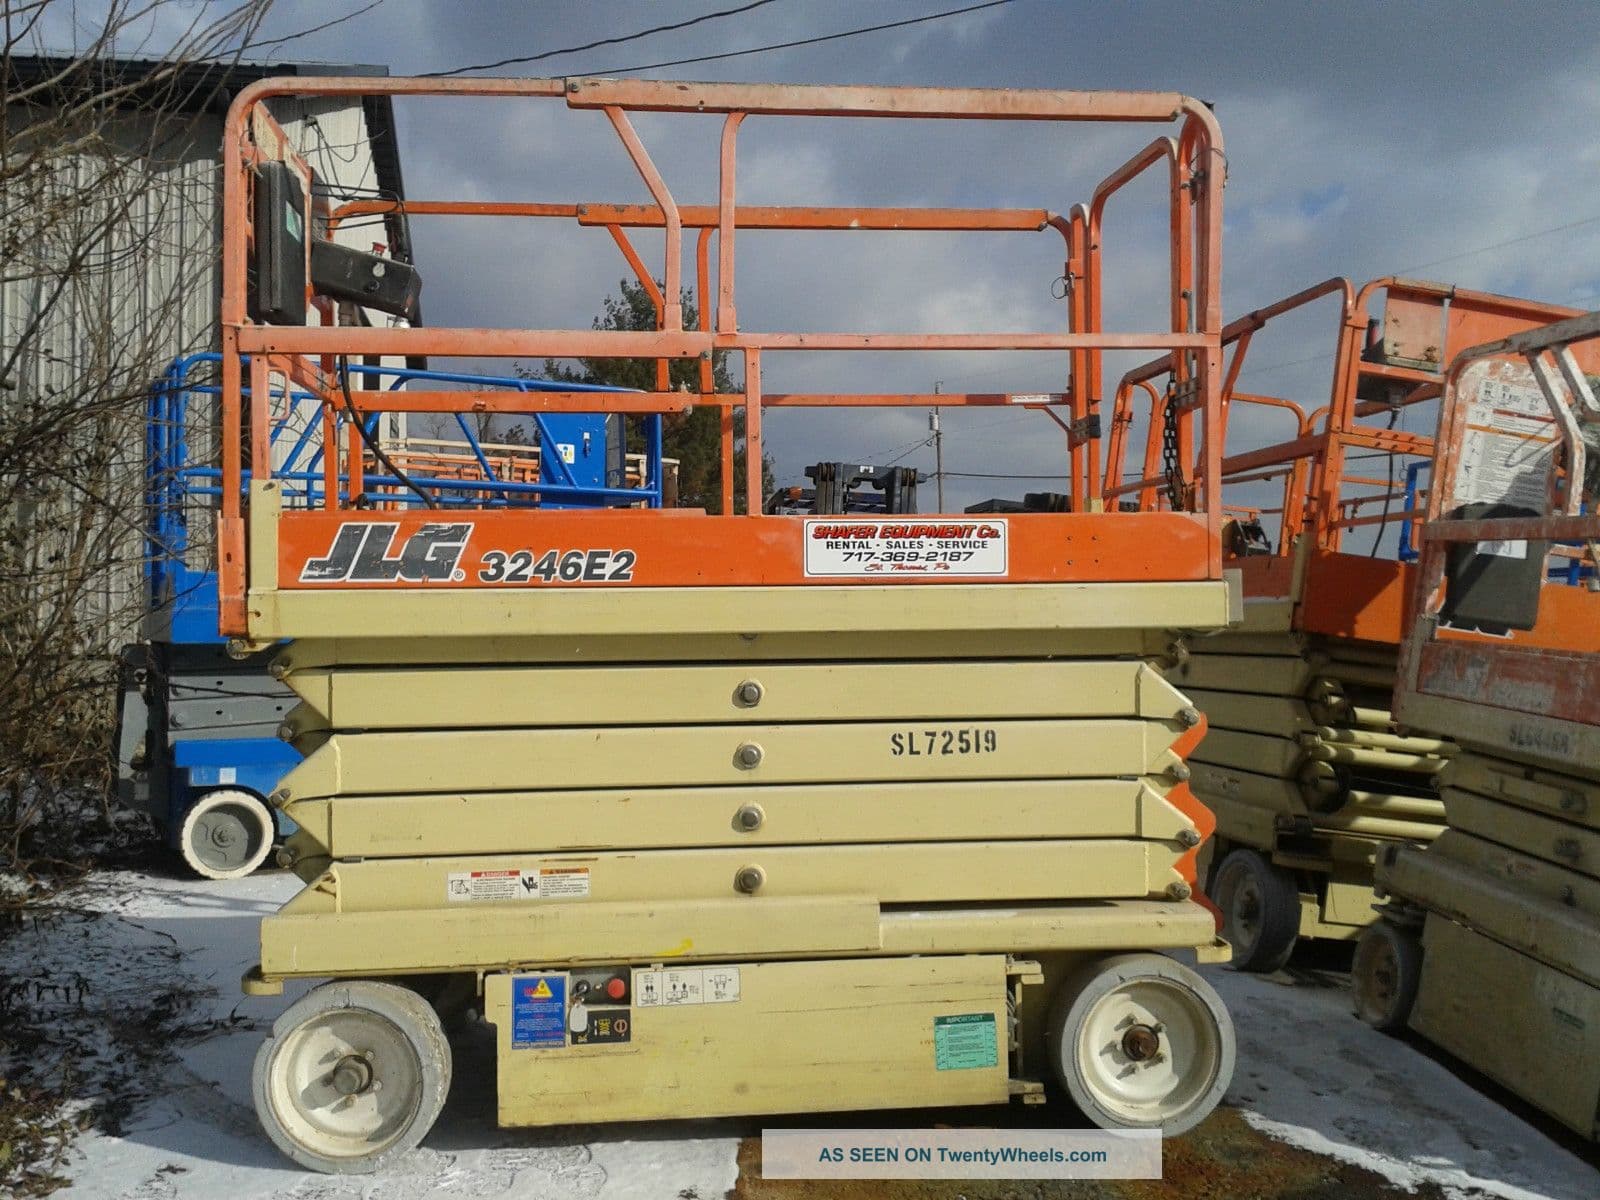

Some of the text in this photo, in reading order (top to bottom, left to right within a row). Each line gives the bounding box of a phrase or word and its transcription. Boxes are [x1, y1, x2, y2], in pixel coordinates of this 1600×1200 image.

[812, 524, 1001, 540] SHAFER EQUIPMENT Co.
[299, 522, 637, 583] JLG 3246E2
[826, 540, 988, 550] RENTAL SALES SERVICE
[842, 551, 974, 562] 717-369-2187
[891, 729, 996, 756] SL72519
